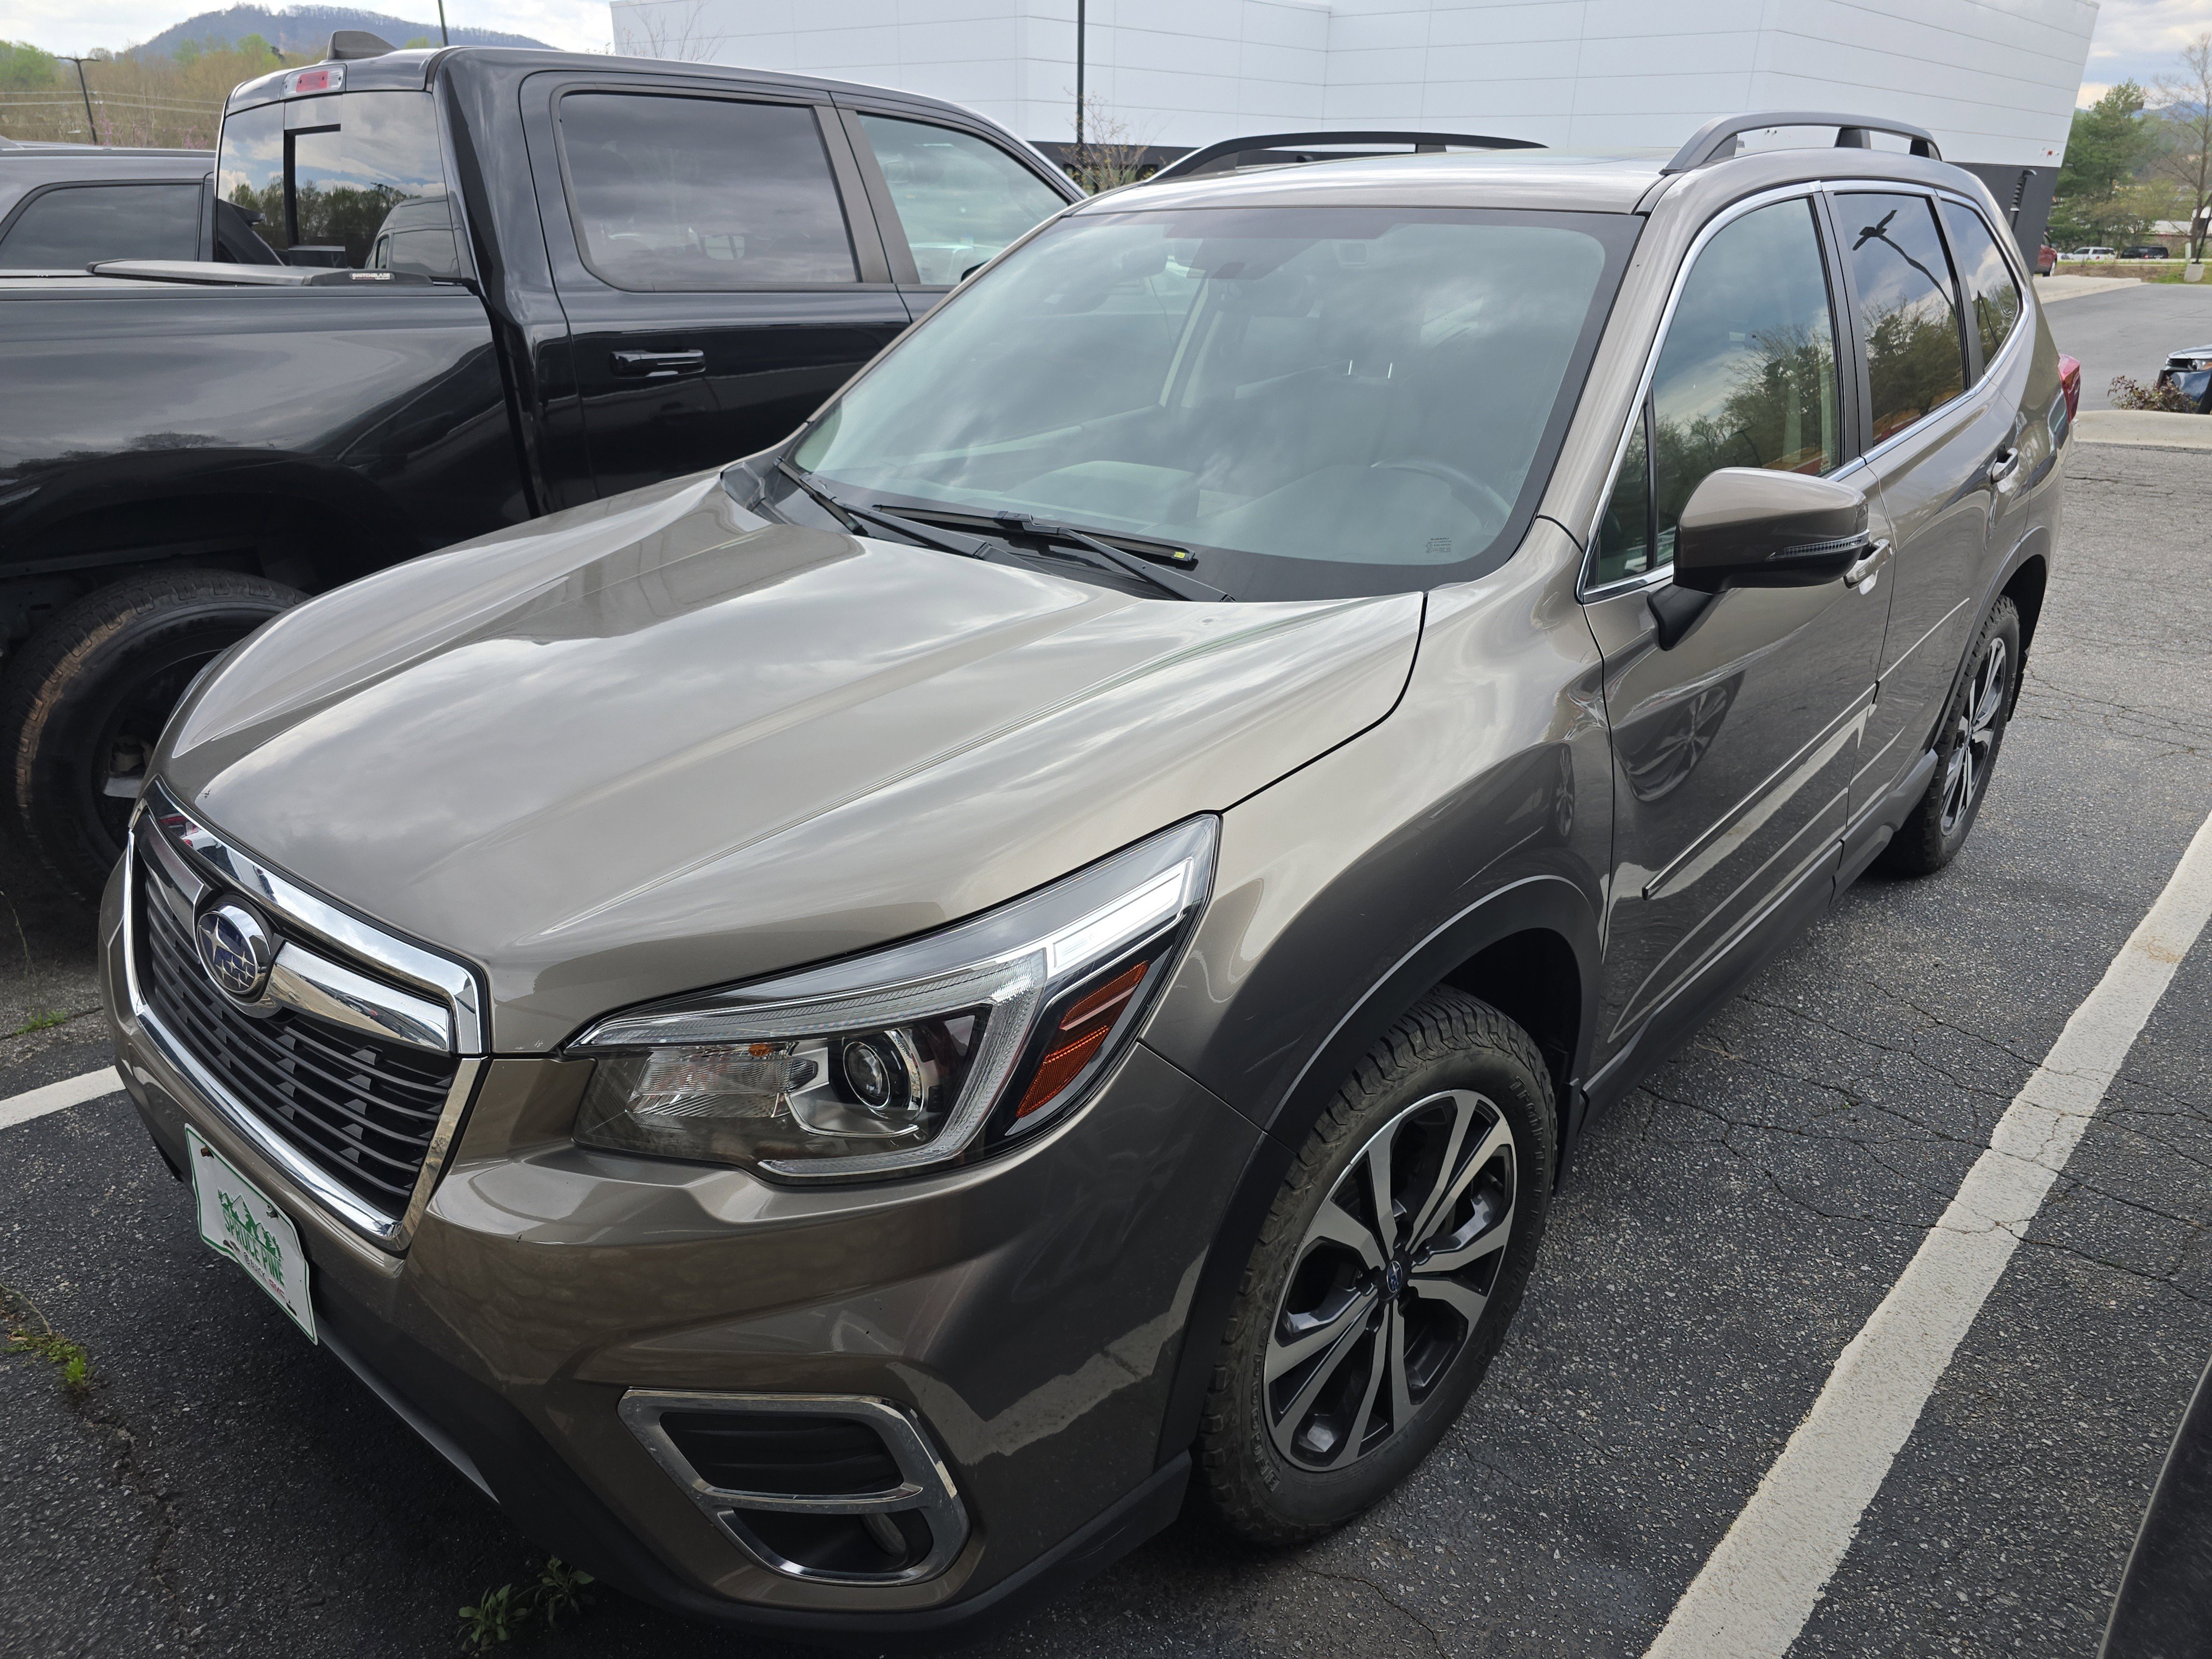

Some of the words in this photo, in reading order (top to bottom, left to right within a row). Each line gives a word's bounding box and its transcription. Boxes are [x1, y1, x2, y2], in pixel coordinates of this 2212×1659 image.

[223, 1208, 260, 1263] SPRUCE
[260, 1245, 285, 1287] PINE
[269, 1278, 285, 1298] GMC
